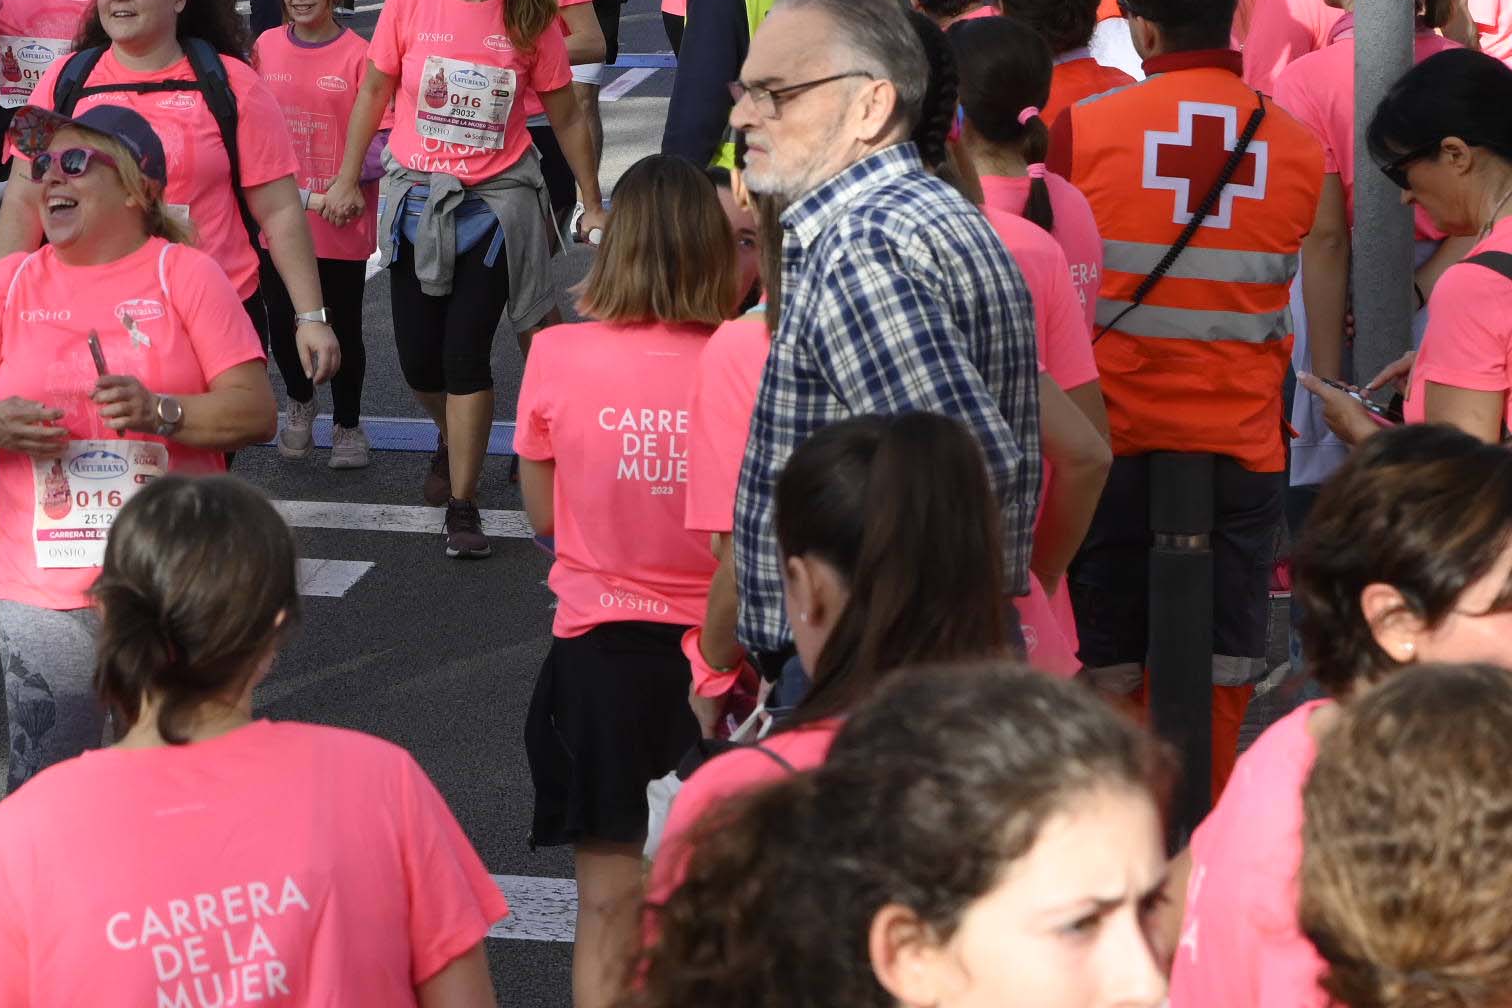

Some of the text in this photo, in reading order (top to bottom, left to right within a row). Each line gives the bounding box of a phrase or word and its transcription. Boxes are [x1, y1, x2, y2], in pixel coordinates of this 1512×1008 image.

[418, 31, 454, 43] OYSHO
[20, 50, 54, 61] ASTURIANA
[453, 74, 487, 87] ASTURIANA
[450, 93, 482, 108] 016
[426, 114, 451, 124] CARRERA
[450, 107, 476, 119] 29032
[422, 124, 450, 136] OYSHO
[408, 153, 469, 174] SUMA
[20, 309, 72, 323] OYSHO
[599, 407, 688, 434] CARRE
[622, 433, 658, 457] DE
[73, 462, 126, 474] ASTURIANA
[617, 458, 688, 483] MUJE
[651, 486, 674, 495] 2023
[76, 490, 122, 508] 016
[84, 514, 113, 525] 2512
[49, 530, 84, 539] CARRERA
[85, 530, 96, 539] DE
[48, 546, 86, 559] OYSHO
[599, 592, 669, 616] OYSHO
[106, 875, 310, 951] CARRERA
[151, 922, 276, 980] DE LA
[156, 959, 290, 1008] MUJER
